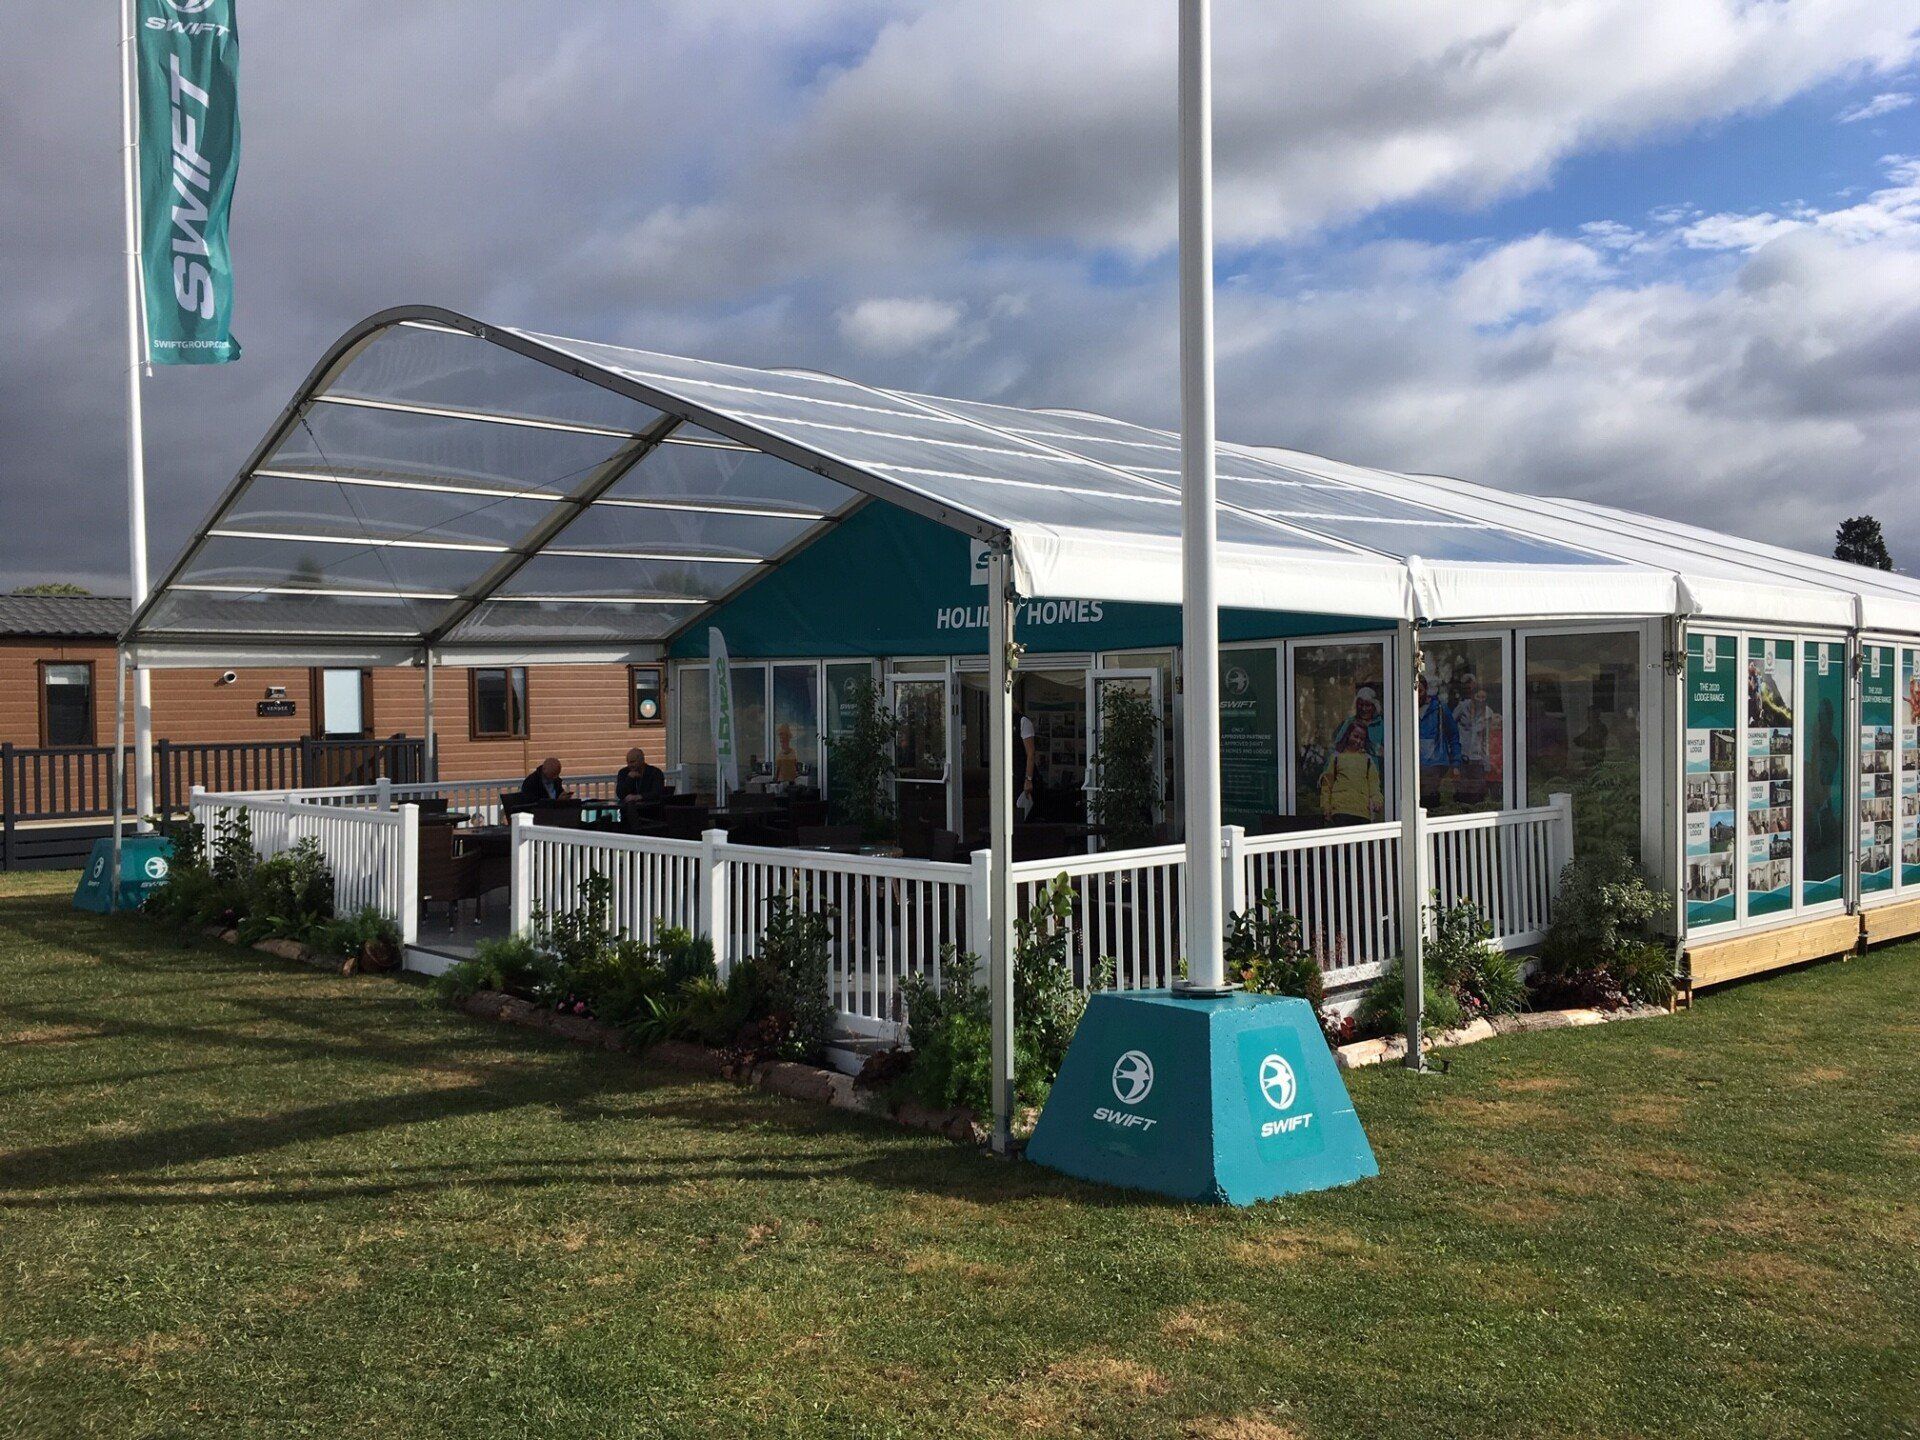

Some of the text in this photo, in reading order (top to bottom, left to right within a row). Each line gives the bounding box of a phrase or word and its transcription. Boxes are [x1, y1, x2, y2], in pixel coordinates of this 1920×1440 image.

[144, 16, 231, 37] SWIFT
[169, 53, 216, 320] SWIFT
[1026, 601, 1104, 626] HOMES
[1219, 700, 1256, 709] SWIFT
[1694, 692, 1725, 702] LODGE RANGE
[1093, 1107, 1157, 1132] SWIFT
[1261, 1112, 1314, 1138] SWIFT
